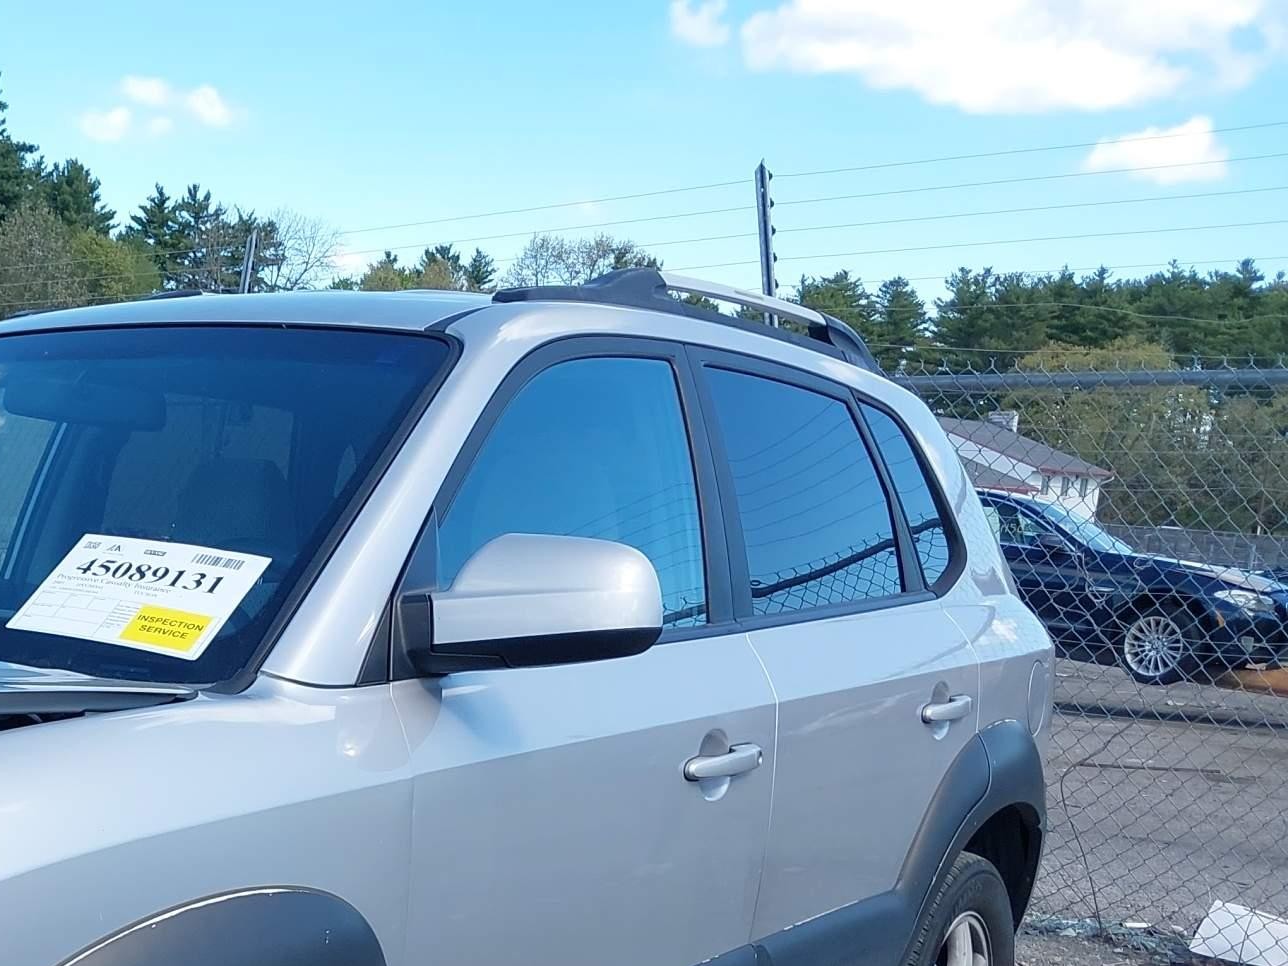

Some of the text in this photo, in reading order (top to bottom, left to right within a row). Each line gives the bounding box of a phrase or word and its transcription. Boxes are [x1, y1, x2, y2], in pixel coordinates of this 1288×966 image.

[76, 558, 224, 595] 45089131
[137, 614, 204, 632] INSPECTION
[138, 624, 189, 640] SERVICE
